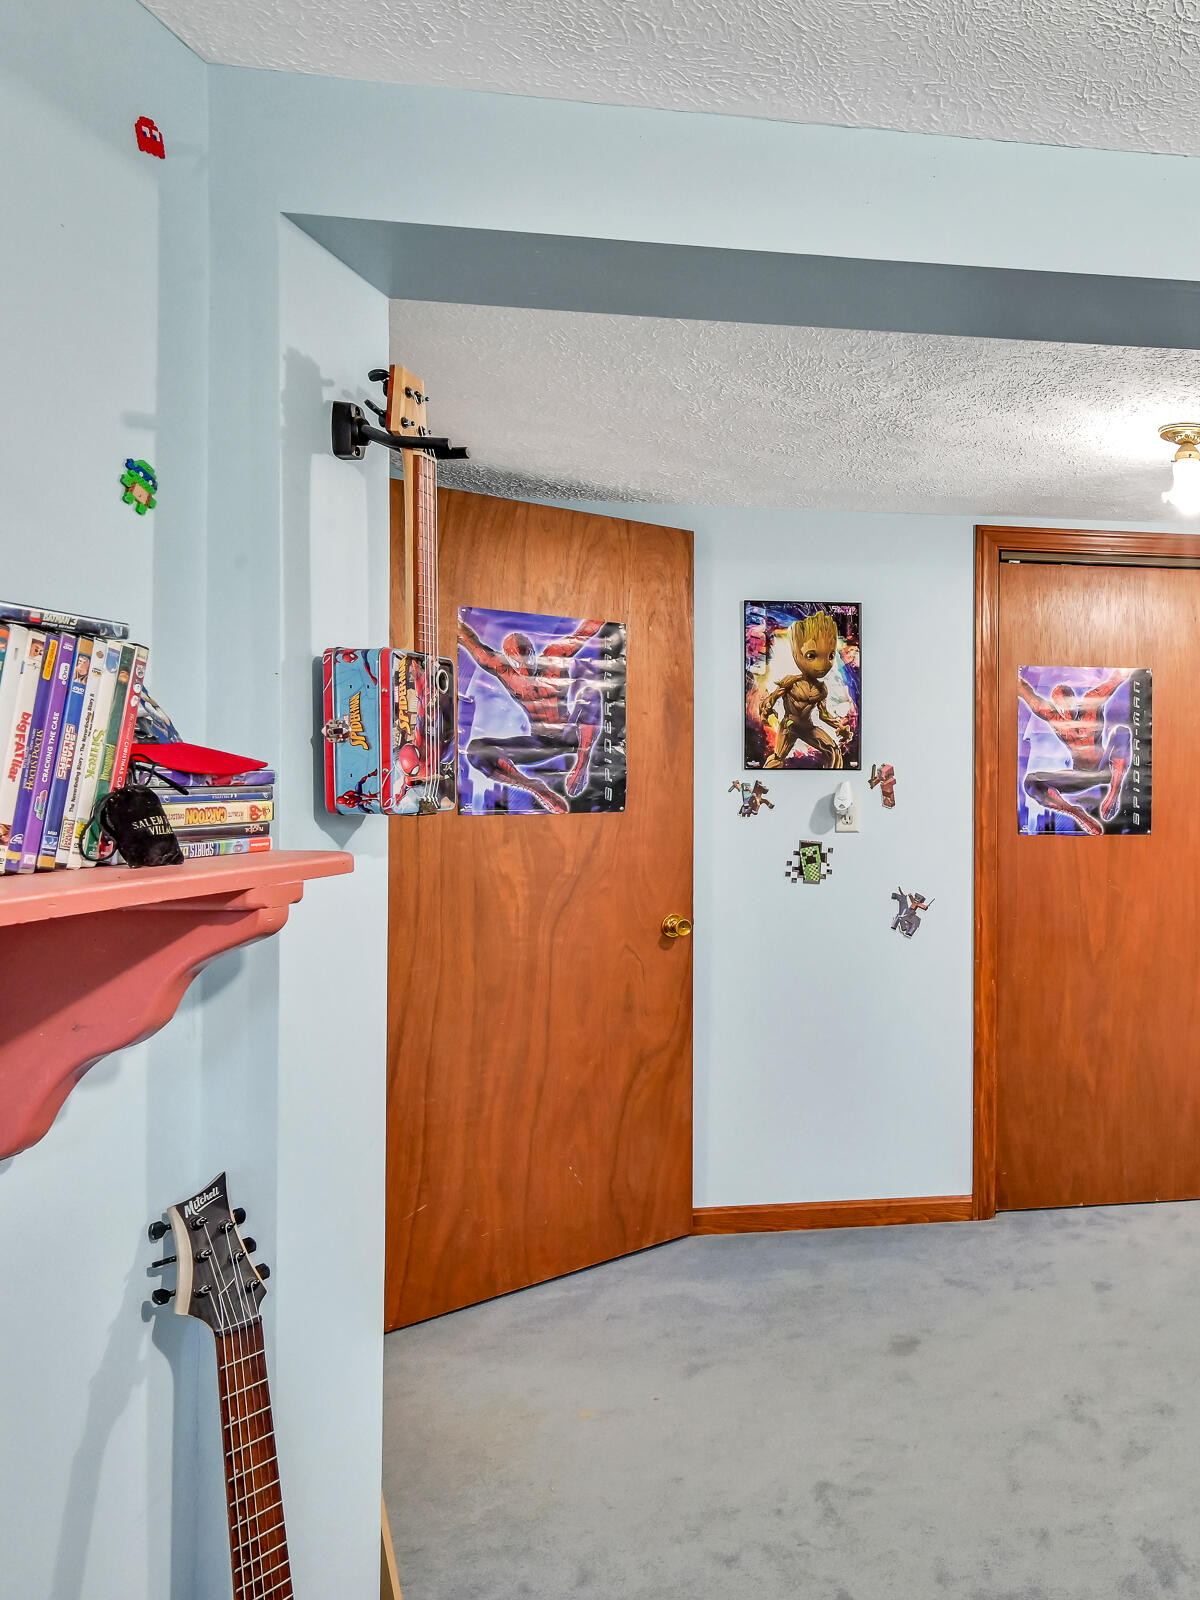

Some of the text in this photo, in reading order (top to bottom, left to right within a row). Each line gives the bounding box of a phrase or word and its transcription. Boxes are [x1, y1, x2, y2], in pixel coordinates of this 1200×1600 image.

[41, 711, 60, 783] CRACKING THE CASE
[119, 741, 129, 775] CHRISTMAS
[1132, 681, 1141, 826] SPIDER-MAN
[131, 815, 164, 830] SALEM
[184, 805, 227, 825] CARTOON
[190, 842, 215, 858] SPORTS
[184, 1186, 222, 1219] Mitchell
